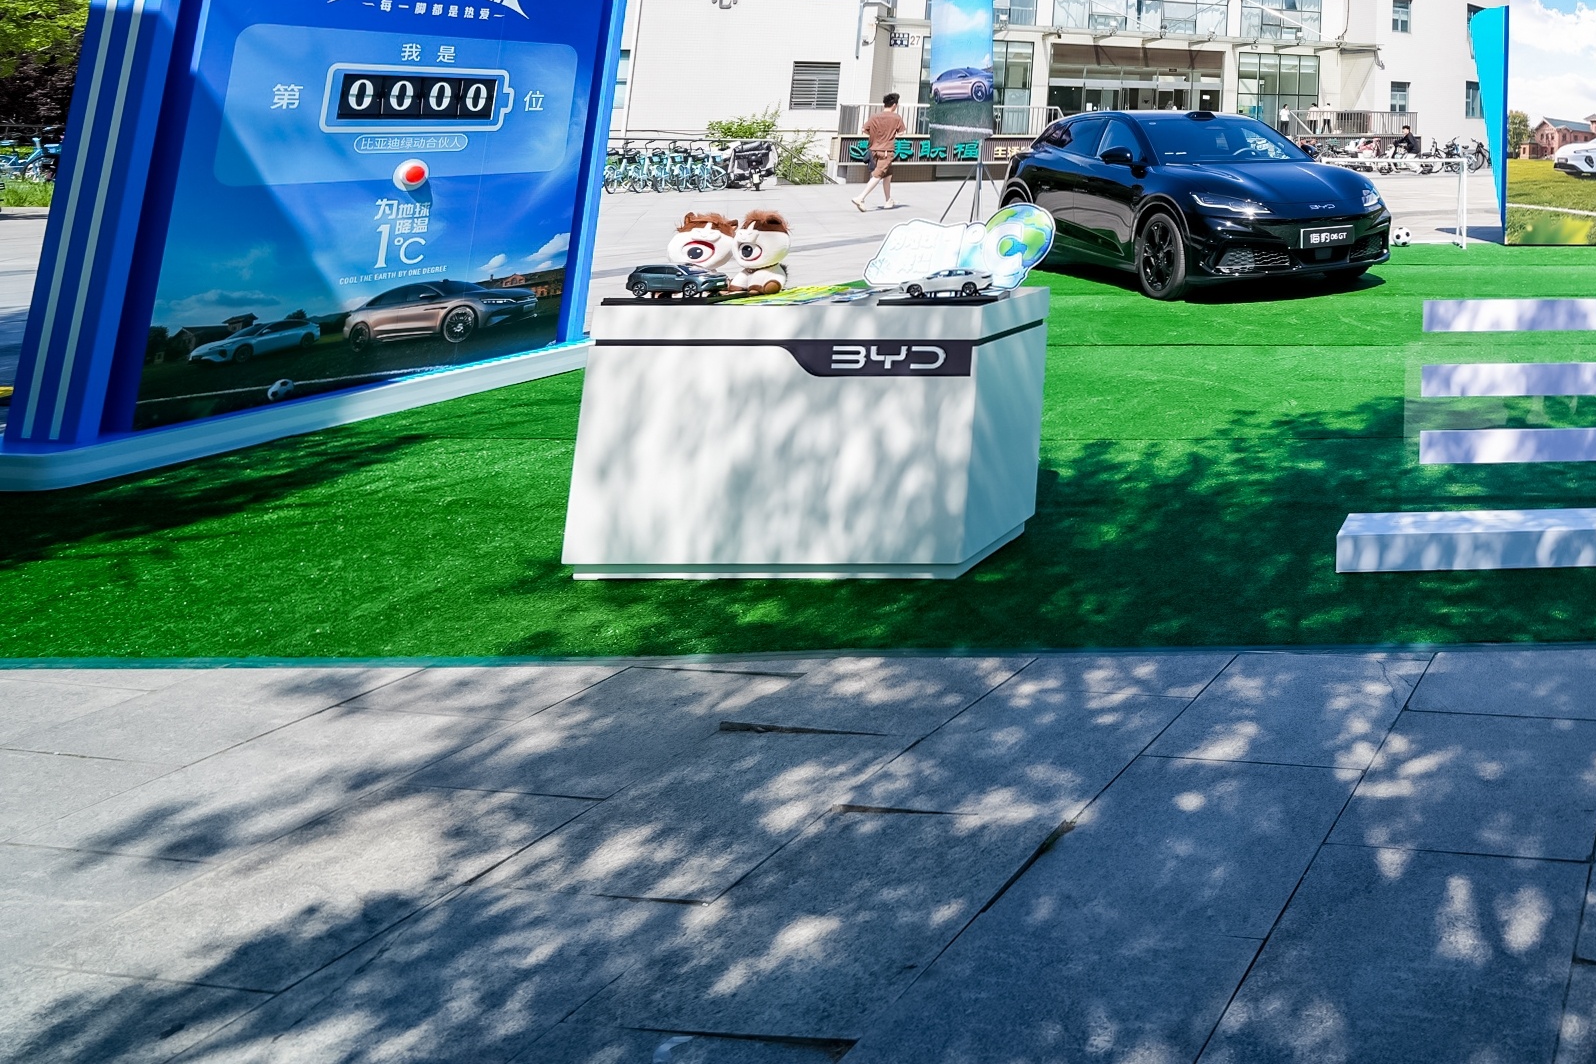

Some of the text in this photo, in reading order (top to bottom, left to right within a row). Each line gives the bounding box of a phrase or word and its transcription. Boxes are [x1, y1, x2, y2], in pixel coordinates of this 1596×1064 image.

[380, 0, 490, 20] 每一脚都是热爱
[910, 35, 920, 45] 27
[401, 43, 456, 63] 我是
[271, 79, 545, 112] 第 0000 位
[360, 137, 461, 150] 比亚迪绿动合伙人
[339, 277, 358, 285] COOL
[360, 274, 373, 282] THE
[374, 271, 397, 281] EARTH
[408, 268, 421, 277] ONE
[422, 265, 448, 275] DEGREE
[831, 345, 947, 370] BYD
